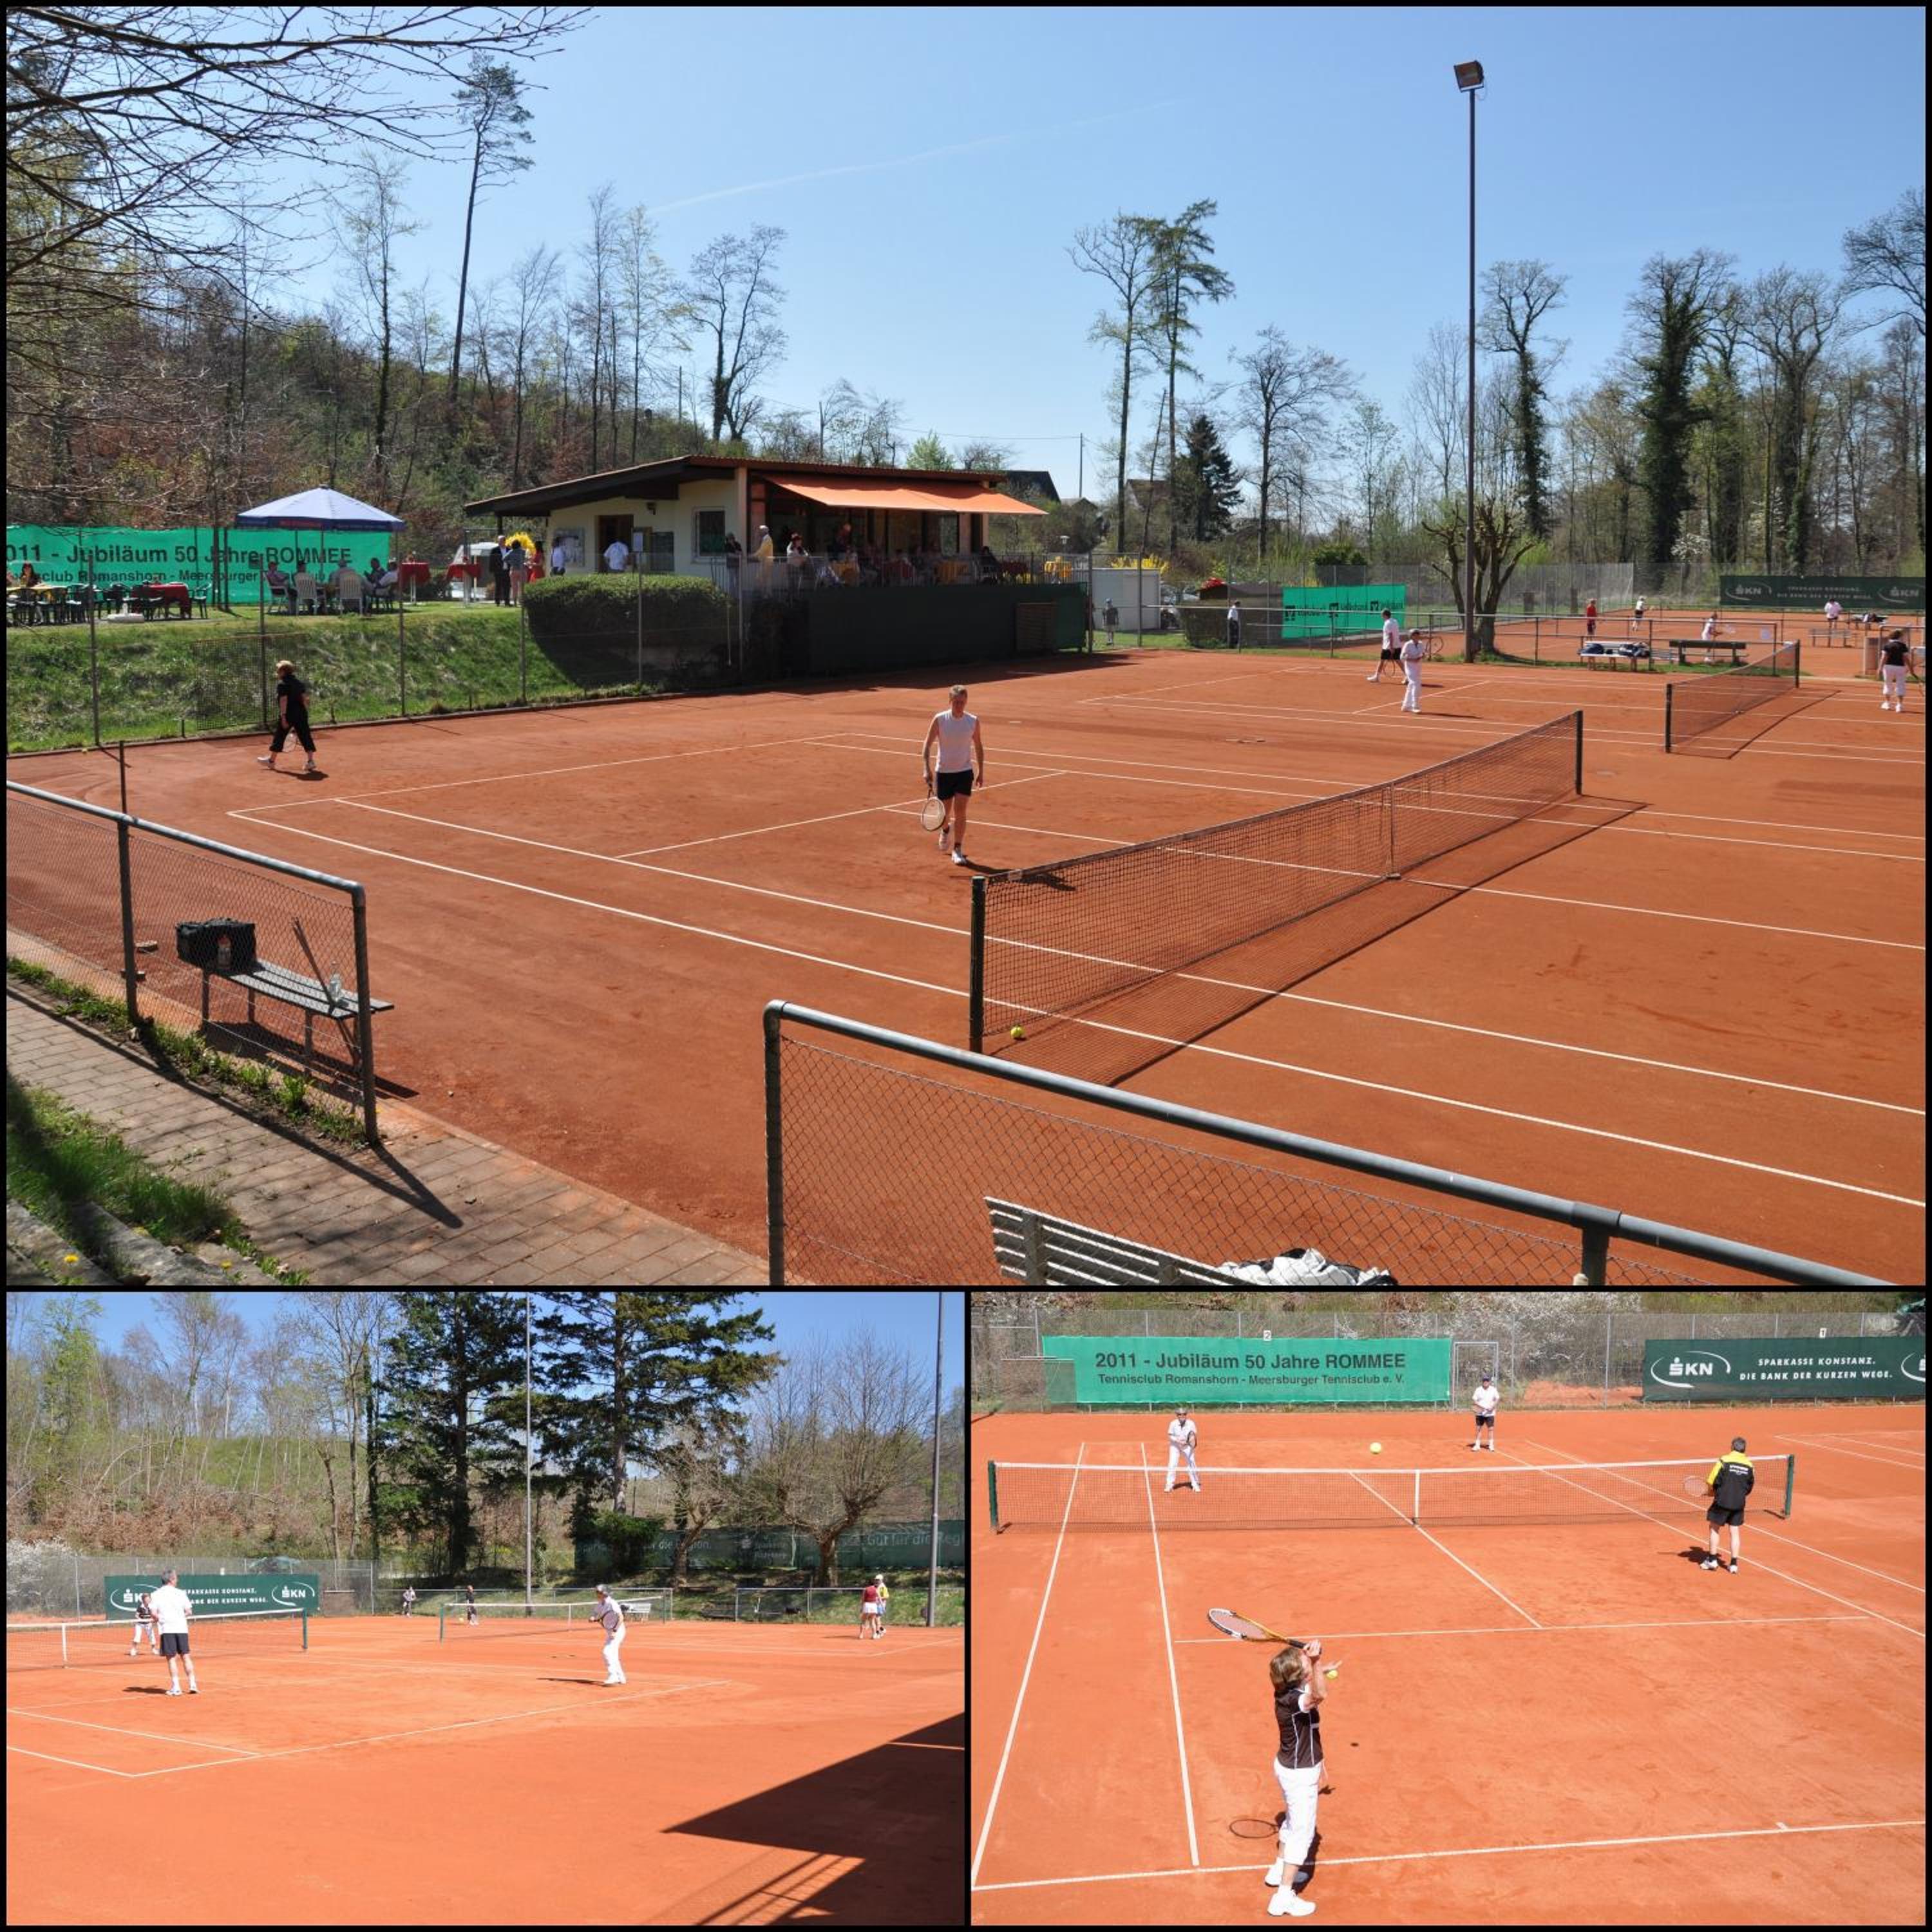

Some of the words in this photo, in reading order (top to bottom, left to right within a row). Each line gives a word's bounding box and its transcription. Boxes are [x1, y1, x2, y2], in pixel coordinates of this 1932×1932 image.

[67, 545, 167, 563] Jubiläum
[175, 546, 198, 562] 50
[266, 547, 353, 563] ROMMEE
[1095, 1352, 1136, 1368] 2011
[1156, 1353, 1239, 1368] Jubiläum
[1245, 1354, 1265, 1369] 50
[1271, 1354, 1320, 1369] Jahre
[1325, 1354, 1406, 1369] ROMMEE
[1758, 1358, 1813, 1366] SPARKASSE
[1818, 1357, 1876, 1365] KONSTANZ.
[1097, 1374, 1162, 1384] Tennisclub
[1165, 1374, 1238, 1385] Romanshorn
[1249, 1375, 1319, 1386] Meersburger
[1322, 1374, 1380, 1385] Tennisclub
[1394, 1375, 1405, 1383] V.
[123, 1588, 145, 1603] SK
